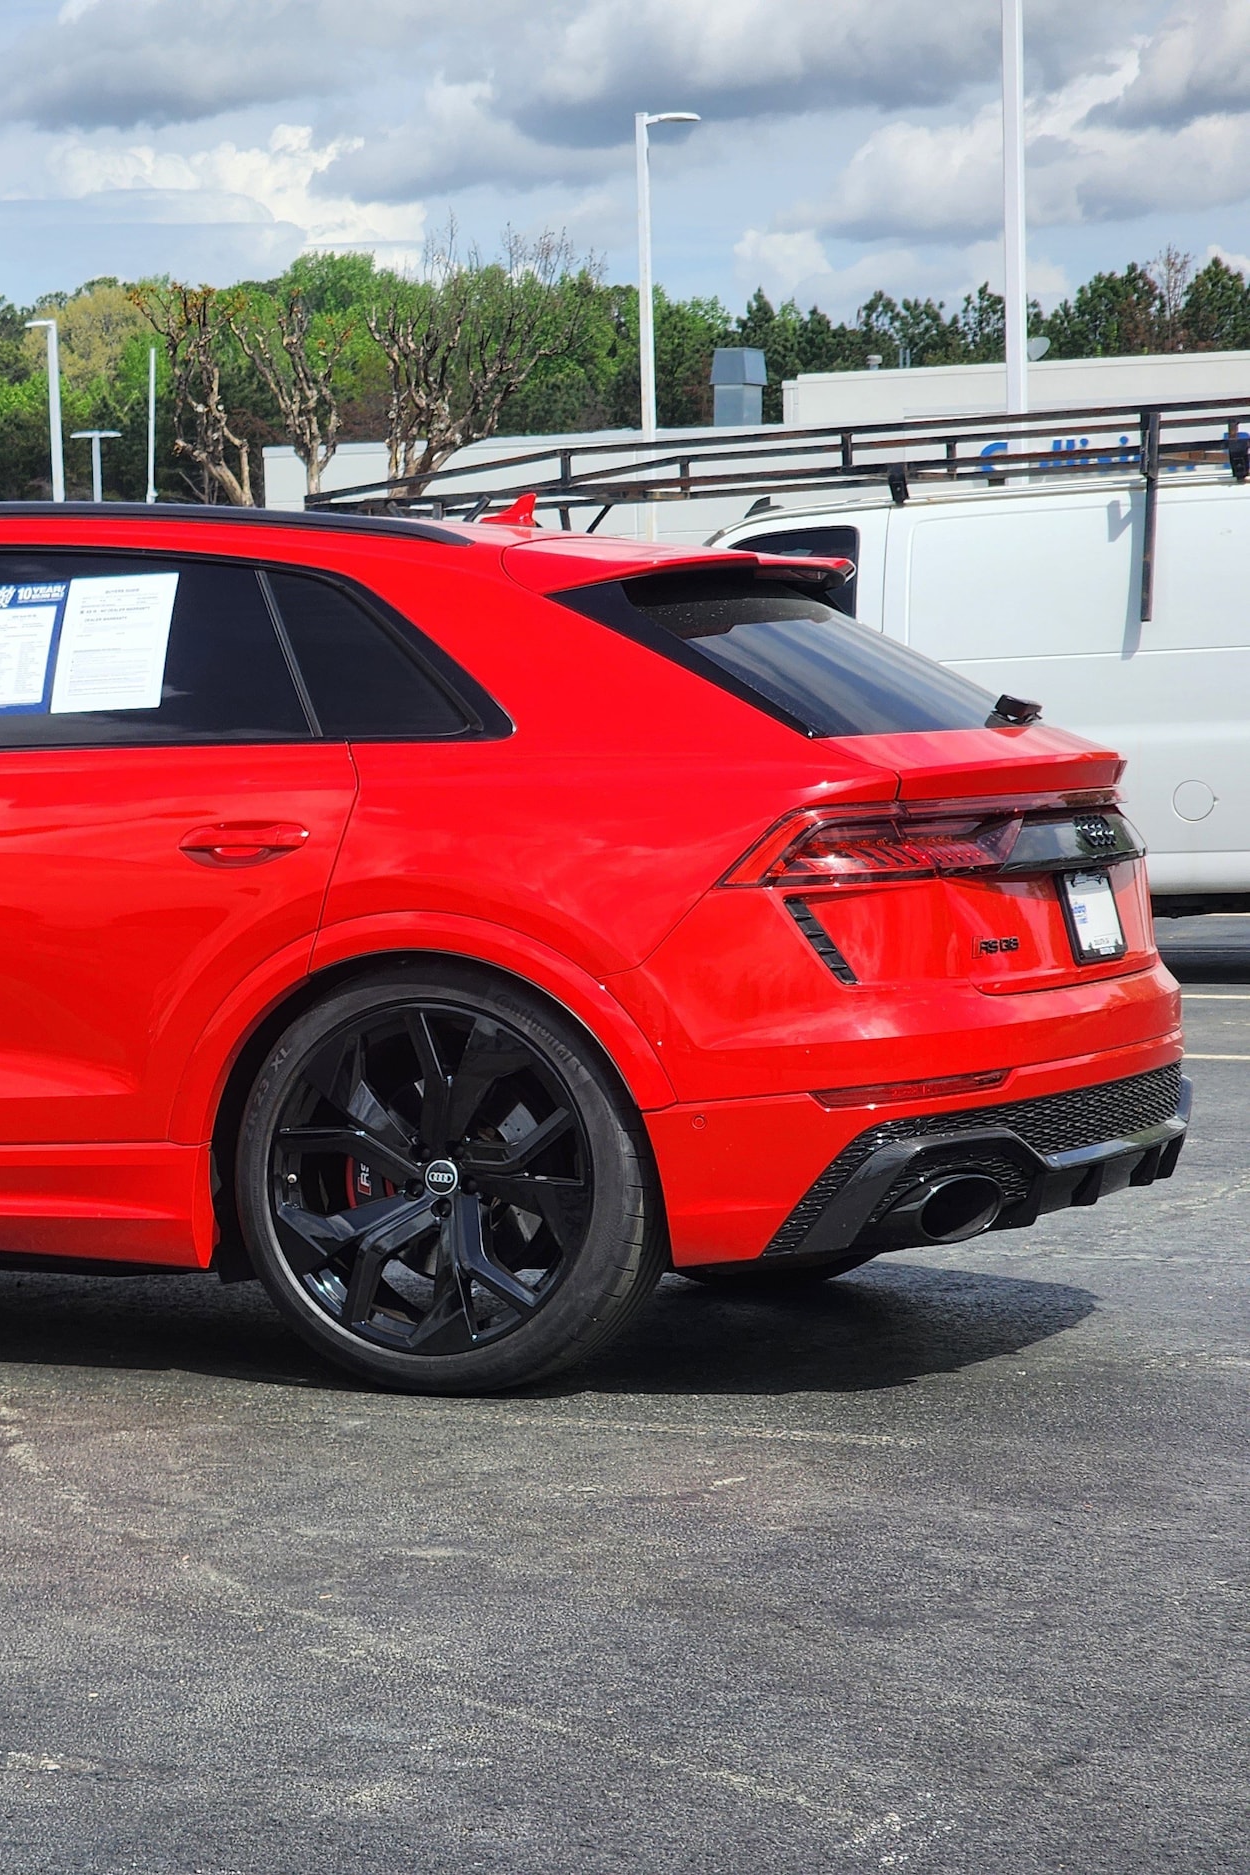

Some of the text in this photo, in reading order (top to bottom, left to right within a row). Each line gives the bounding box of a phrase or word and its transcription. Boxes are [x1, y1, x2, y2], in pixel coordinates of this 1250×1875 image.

[17, 587, 32, 600] 10
[254, 1078, 270, 1107] 23
[270, 1047, 292, 1073] XL
